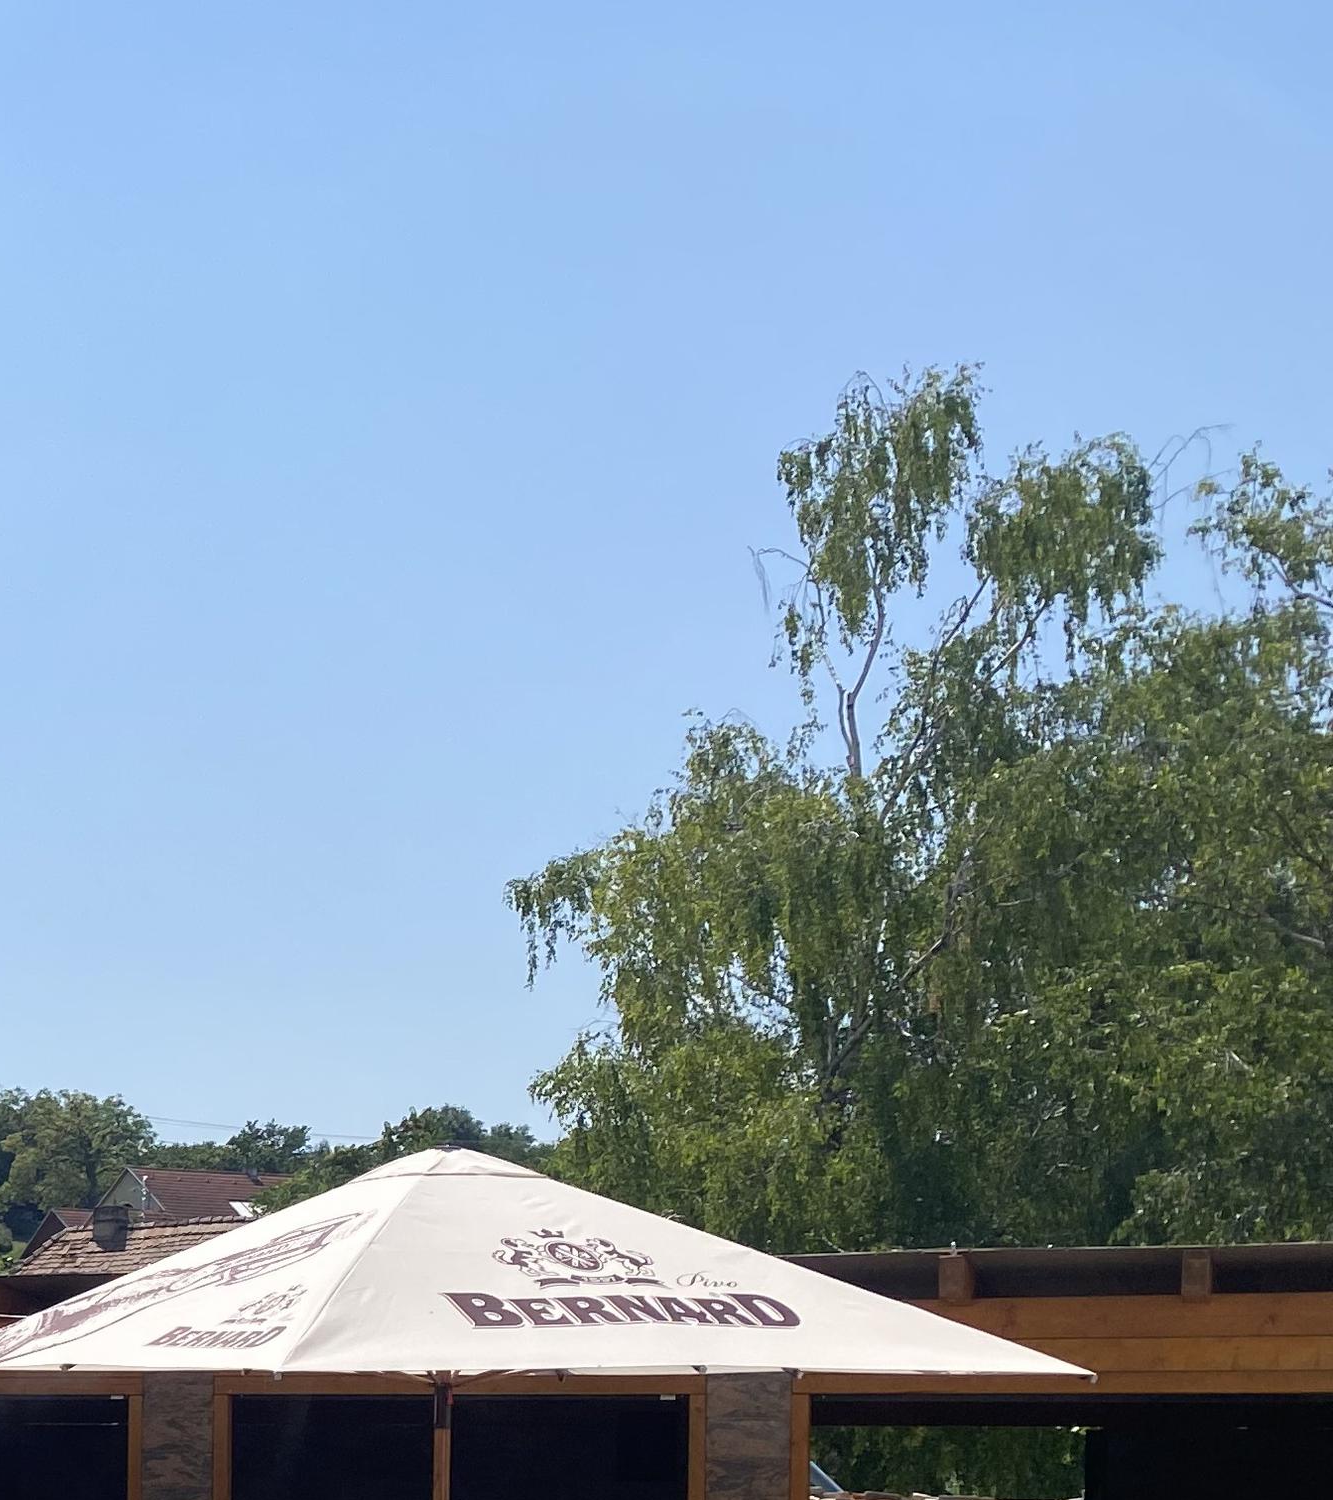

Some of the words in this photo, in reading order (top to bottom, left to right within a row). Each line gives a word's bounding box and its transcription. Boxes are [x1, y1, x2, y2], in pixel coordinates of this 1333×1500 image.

[676, 1270, 739, 1289] Pivo
[438, 1292, 802, 1330] BERNARD
[143, 1325, 287, 1349] BERNARD
